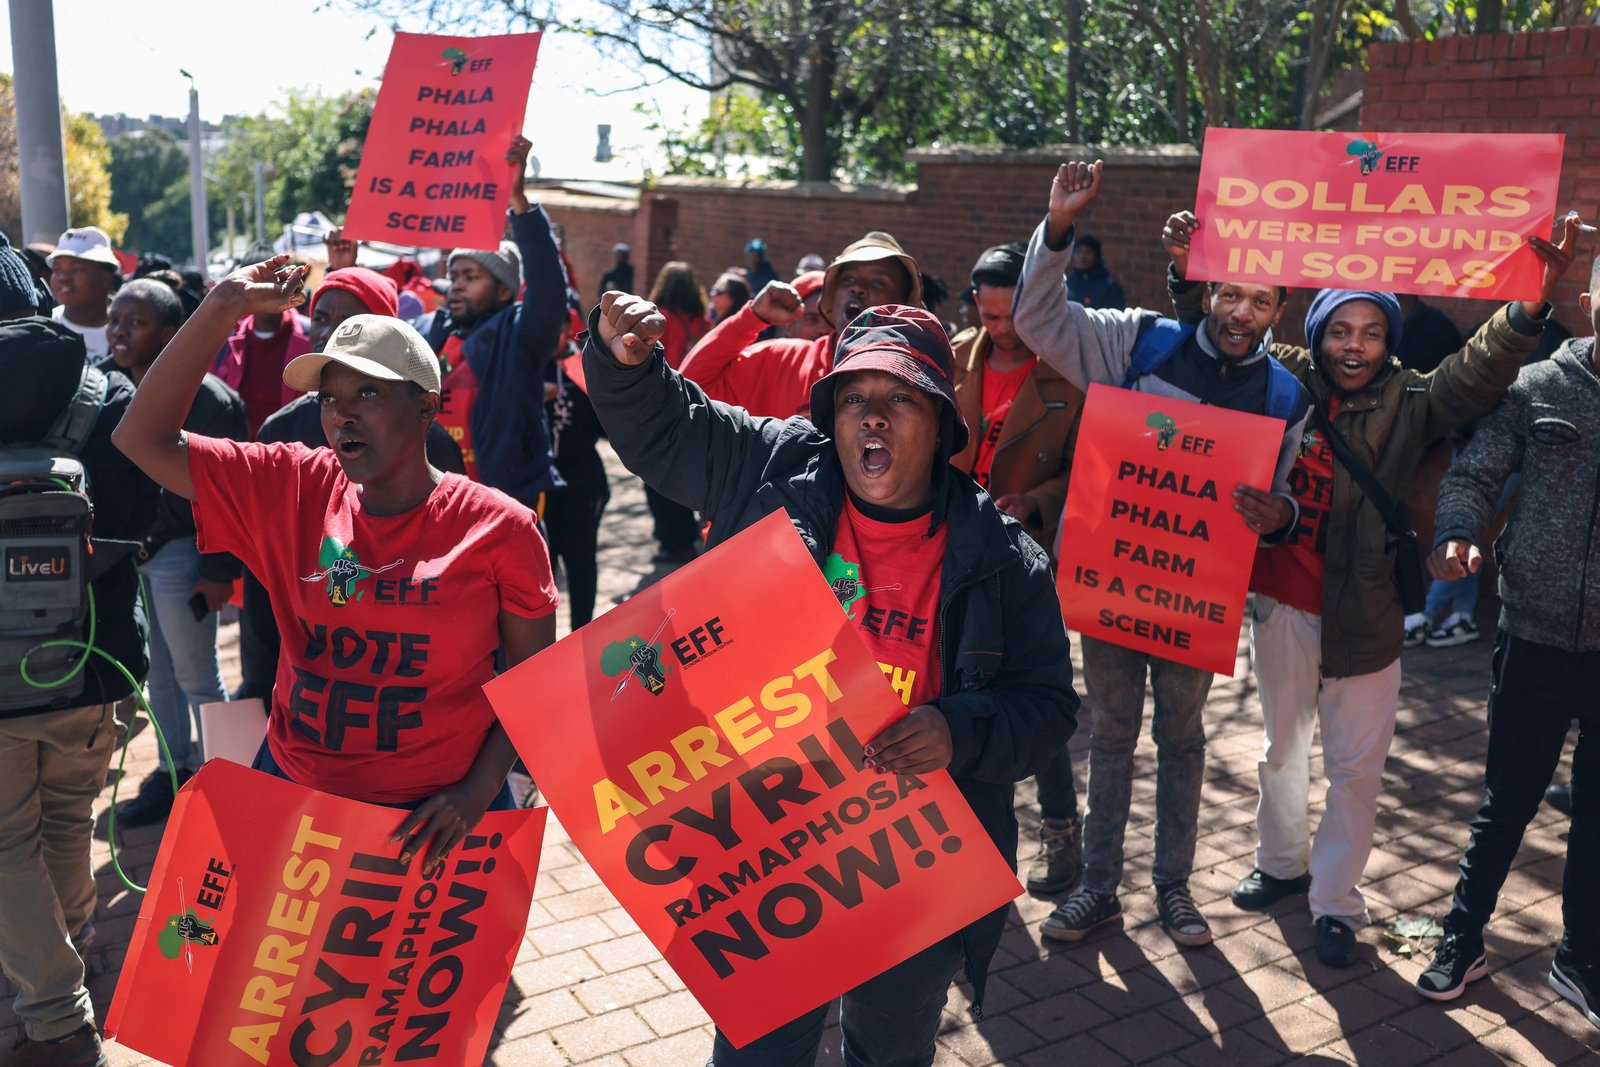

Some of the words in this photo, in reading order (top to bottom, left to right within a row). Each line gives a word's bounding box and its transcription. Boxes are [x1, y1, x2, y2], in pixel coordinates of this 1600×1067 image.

[470, 58, 494, 72] EFF
[417, 86, 494, 104] PHALA
[409, 117, 486, 136] PHALA
[408, 149, 474, 167] FARM
[1386, 156, 1420, 170] EFF
[369, 177, 393, 194] IS
[398, 181, 416, 198] A
[425, 183, 497, 200] CRIME
[1215, 177, 1532, 218] DOLLARS
[386, 212, 466, 232] SCENE
[1214, 217, 1342, 244] WERE
[1355, 224, 1523, 252] FOUND
[1227, 247, 1284, 276] IN
[1299, 252, 1497, 289] SOFAS
[1180, 434, 1215, 455] EFF
[1117, 460, 1218, 502] PHALA
[1111, 499, 1210, 542] PHALA
[1113, 539, 1196, 577] FARM
[375, 577, 439, 601] EFF
[1074, 566, 1100, 588] IS
[1107, 576, 1126, 596] A
[1135, 583, 1226, 624] CRIME
[670, 616, 724, 666] EFF
[861, 604, 929, 640] EFF
[1098, 608, 1191, 650] SCENE
[298, 615, 430, 678] VOTE
[289, 665, 428, 752] EFF
[592, 647, 845, 834] ARREST
[664, 772, 928, 927] RAMAPHOSA
[197, 858, 230, 909] EFF
[690, 801, 963, 980] NOW!!
[228, 815, 342, 1066] ARREST
[358, 852, 449, 1066] RAMAPHOS
[394, 831, 503, 1062] NOW!!
